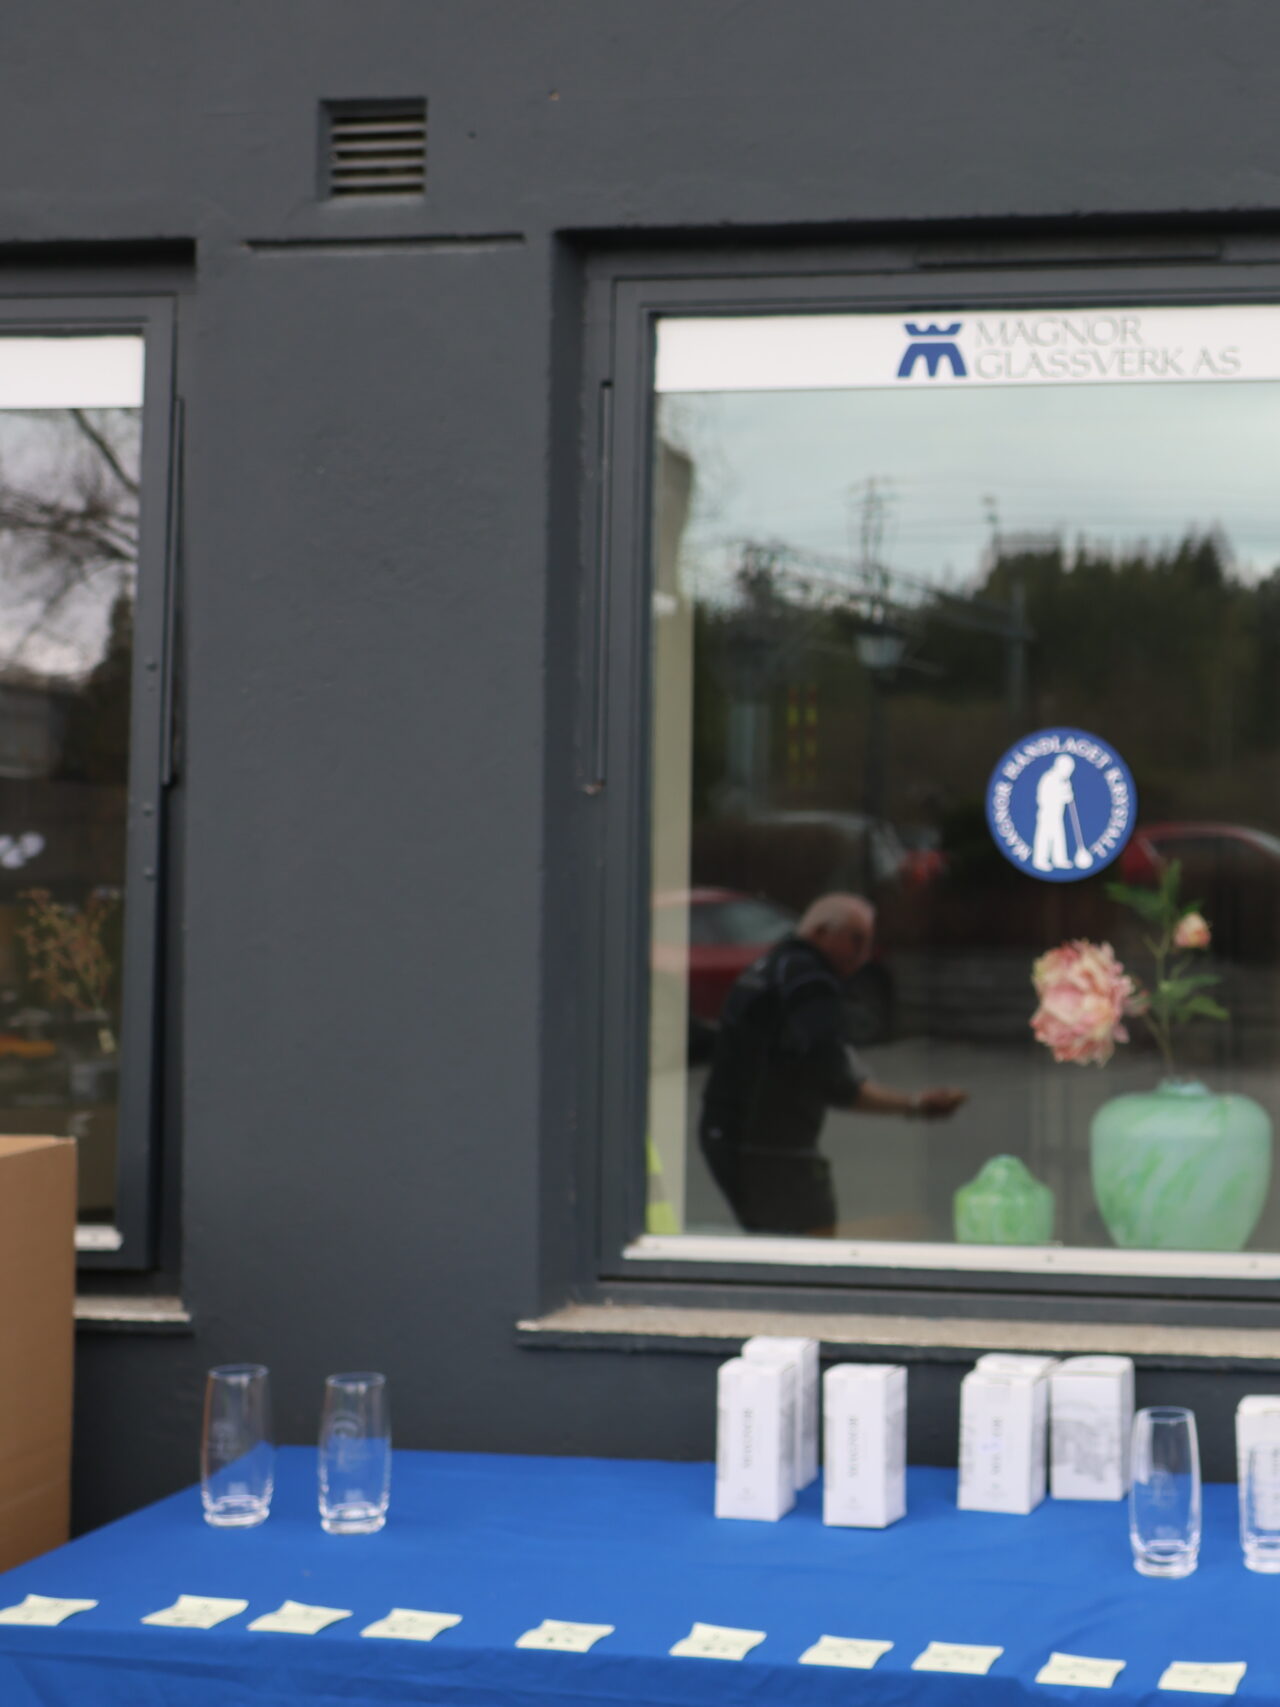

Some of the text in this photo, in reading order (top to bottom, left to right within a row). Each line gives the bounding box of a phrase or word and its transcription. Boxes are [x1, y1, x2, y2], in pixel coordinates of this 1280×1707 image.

[975, 315, 1143, 347] MAGNOR
[974, 345, 1243, 380] GLASSVERK AS
[992, 780, 1032, 863] MAGNOR
[1088, 766, 1130, 859] KRYSTALL
